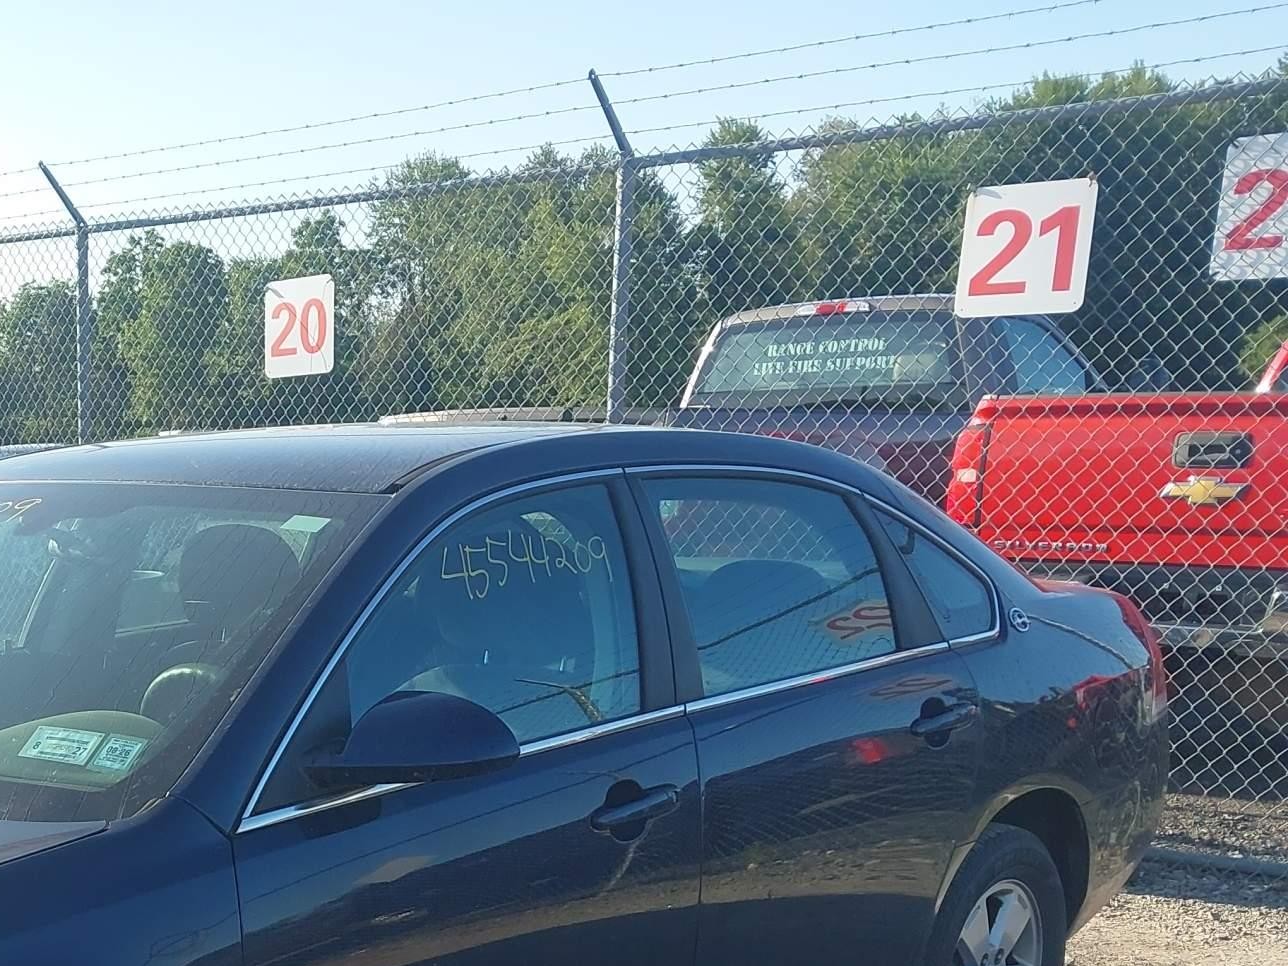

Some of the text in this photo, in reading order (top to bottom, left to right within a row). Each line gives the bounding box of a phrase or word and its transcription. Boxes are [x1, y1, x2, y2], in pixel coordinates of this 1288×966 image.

[968, 205, 1081, 297] 21
[270, 297, 327, 358] 20
[440, 529, 614, 600] 45544209
